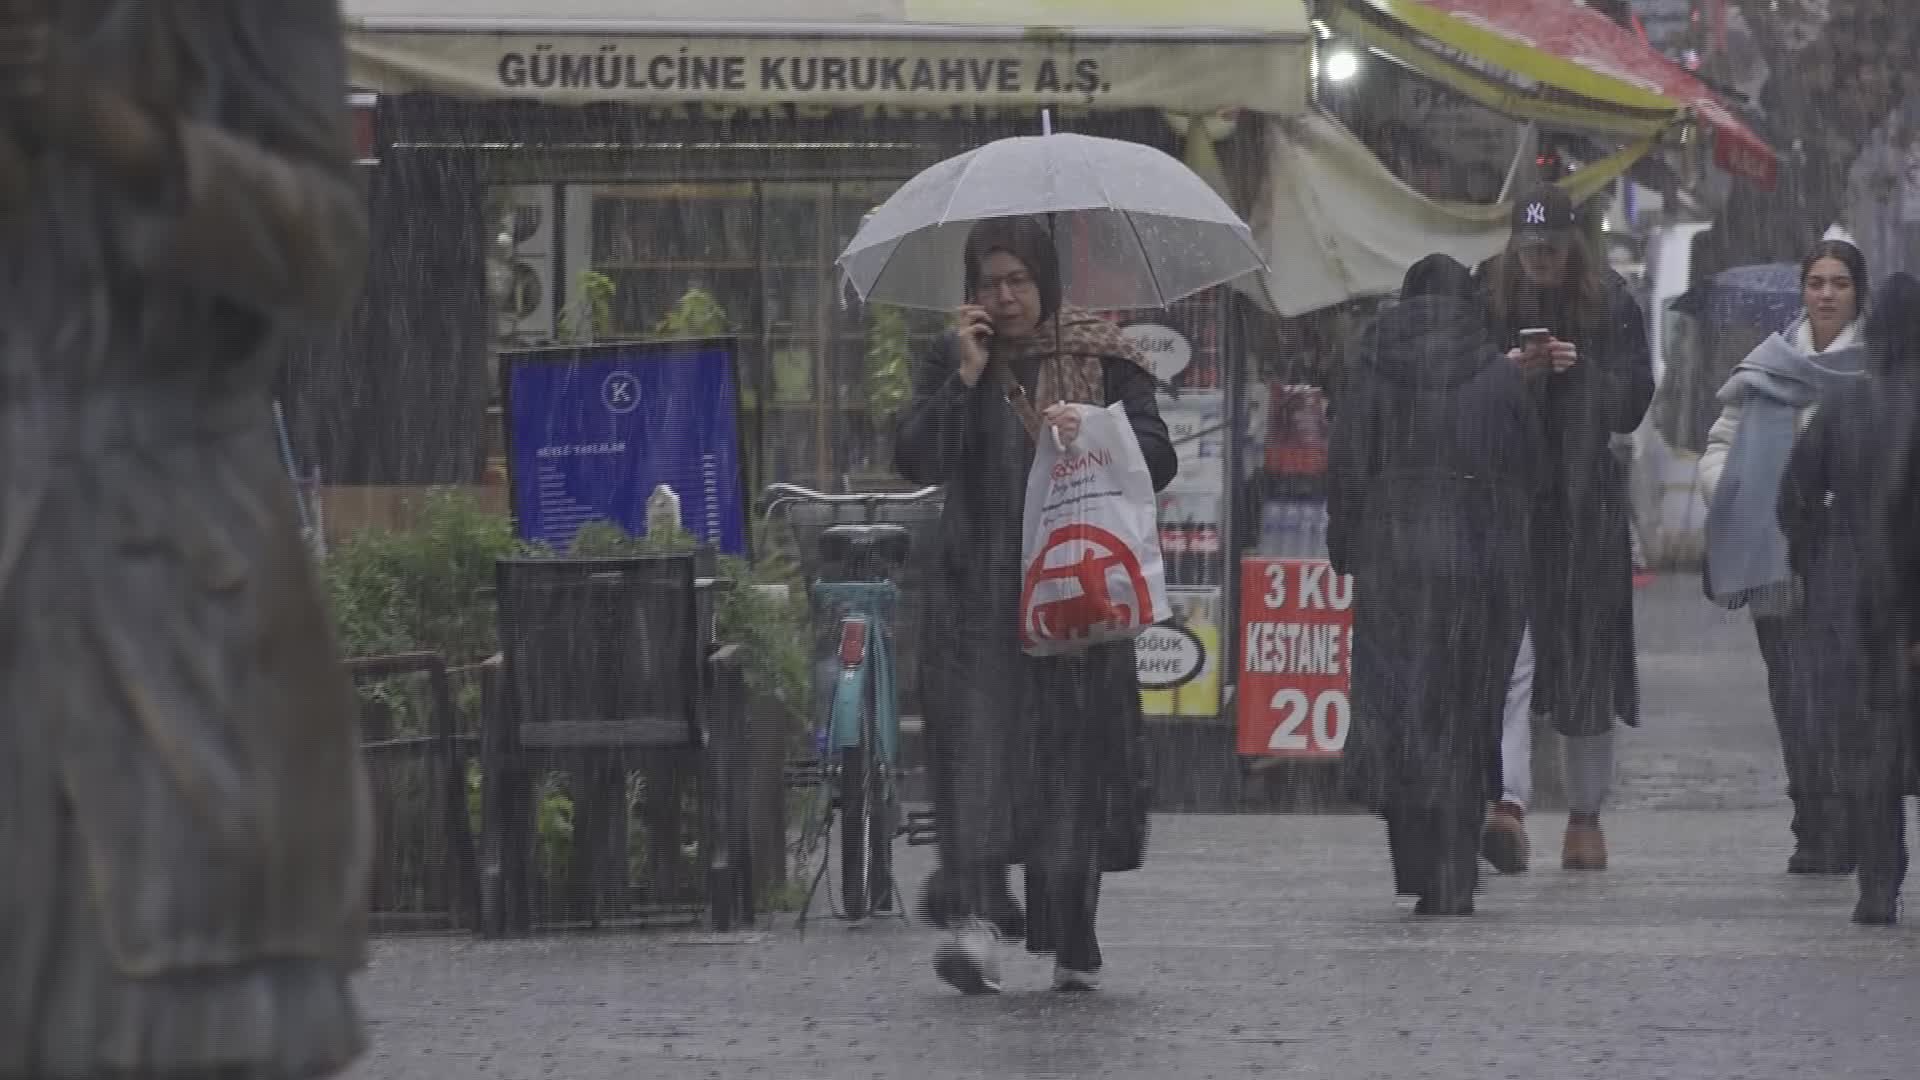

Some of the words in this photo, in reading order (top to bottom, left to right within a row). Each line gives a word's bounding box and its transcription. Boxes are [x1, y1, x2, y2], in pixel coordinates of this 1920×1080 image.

[499, 44, 747, 90] GÜMÜLCİNE
[759, 55, 1023, 93] KURUKAHVE
[1033, 57, 1112, 103] A.Ş.
[1526, 202, 1545, 223] NY
[1263, 563, 1286, 610] 3
[1299, 563, 1354, 611] KU
[1136, 634, 1184, 652] OĞUK
[1137, 658, 1184, 673] AHVE
[1245, 622, 1341, 676] KESTANE
[1268, 688, 1352, 753] 20
